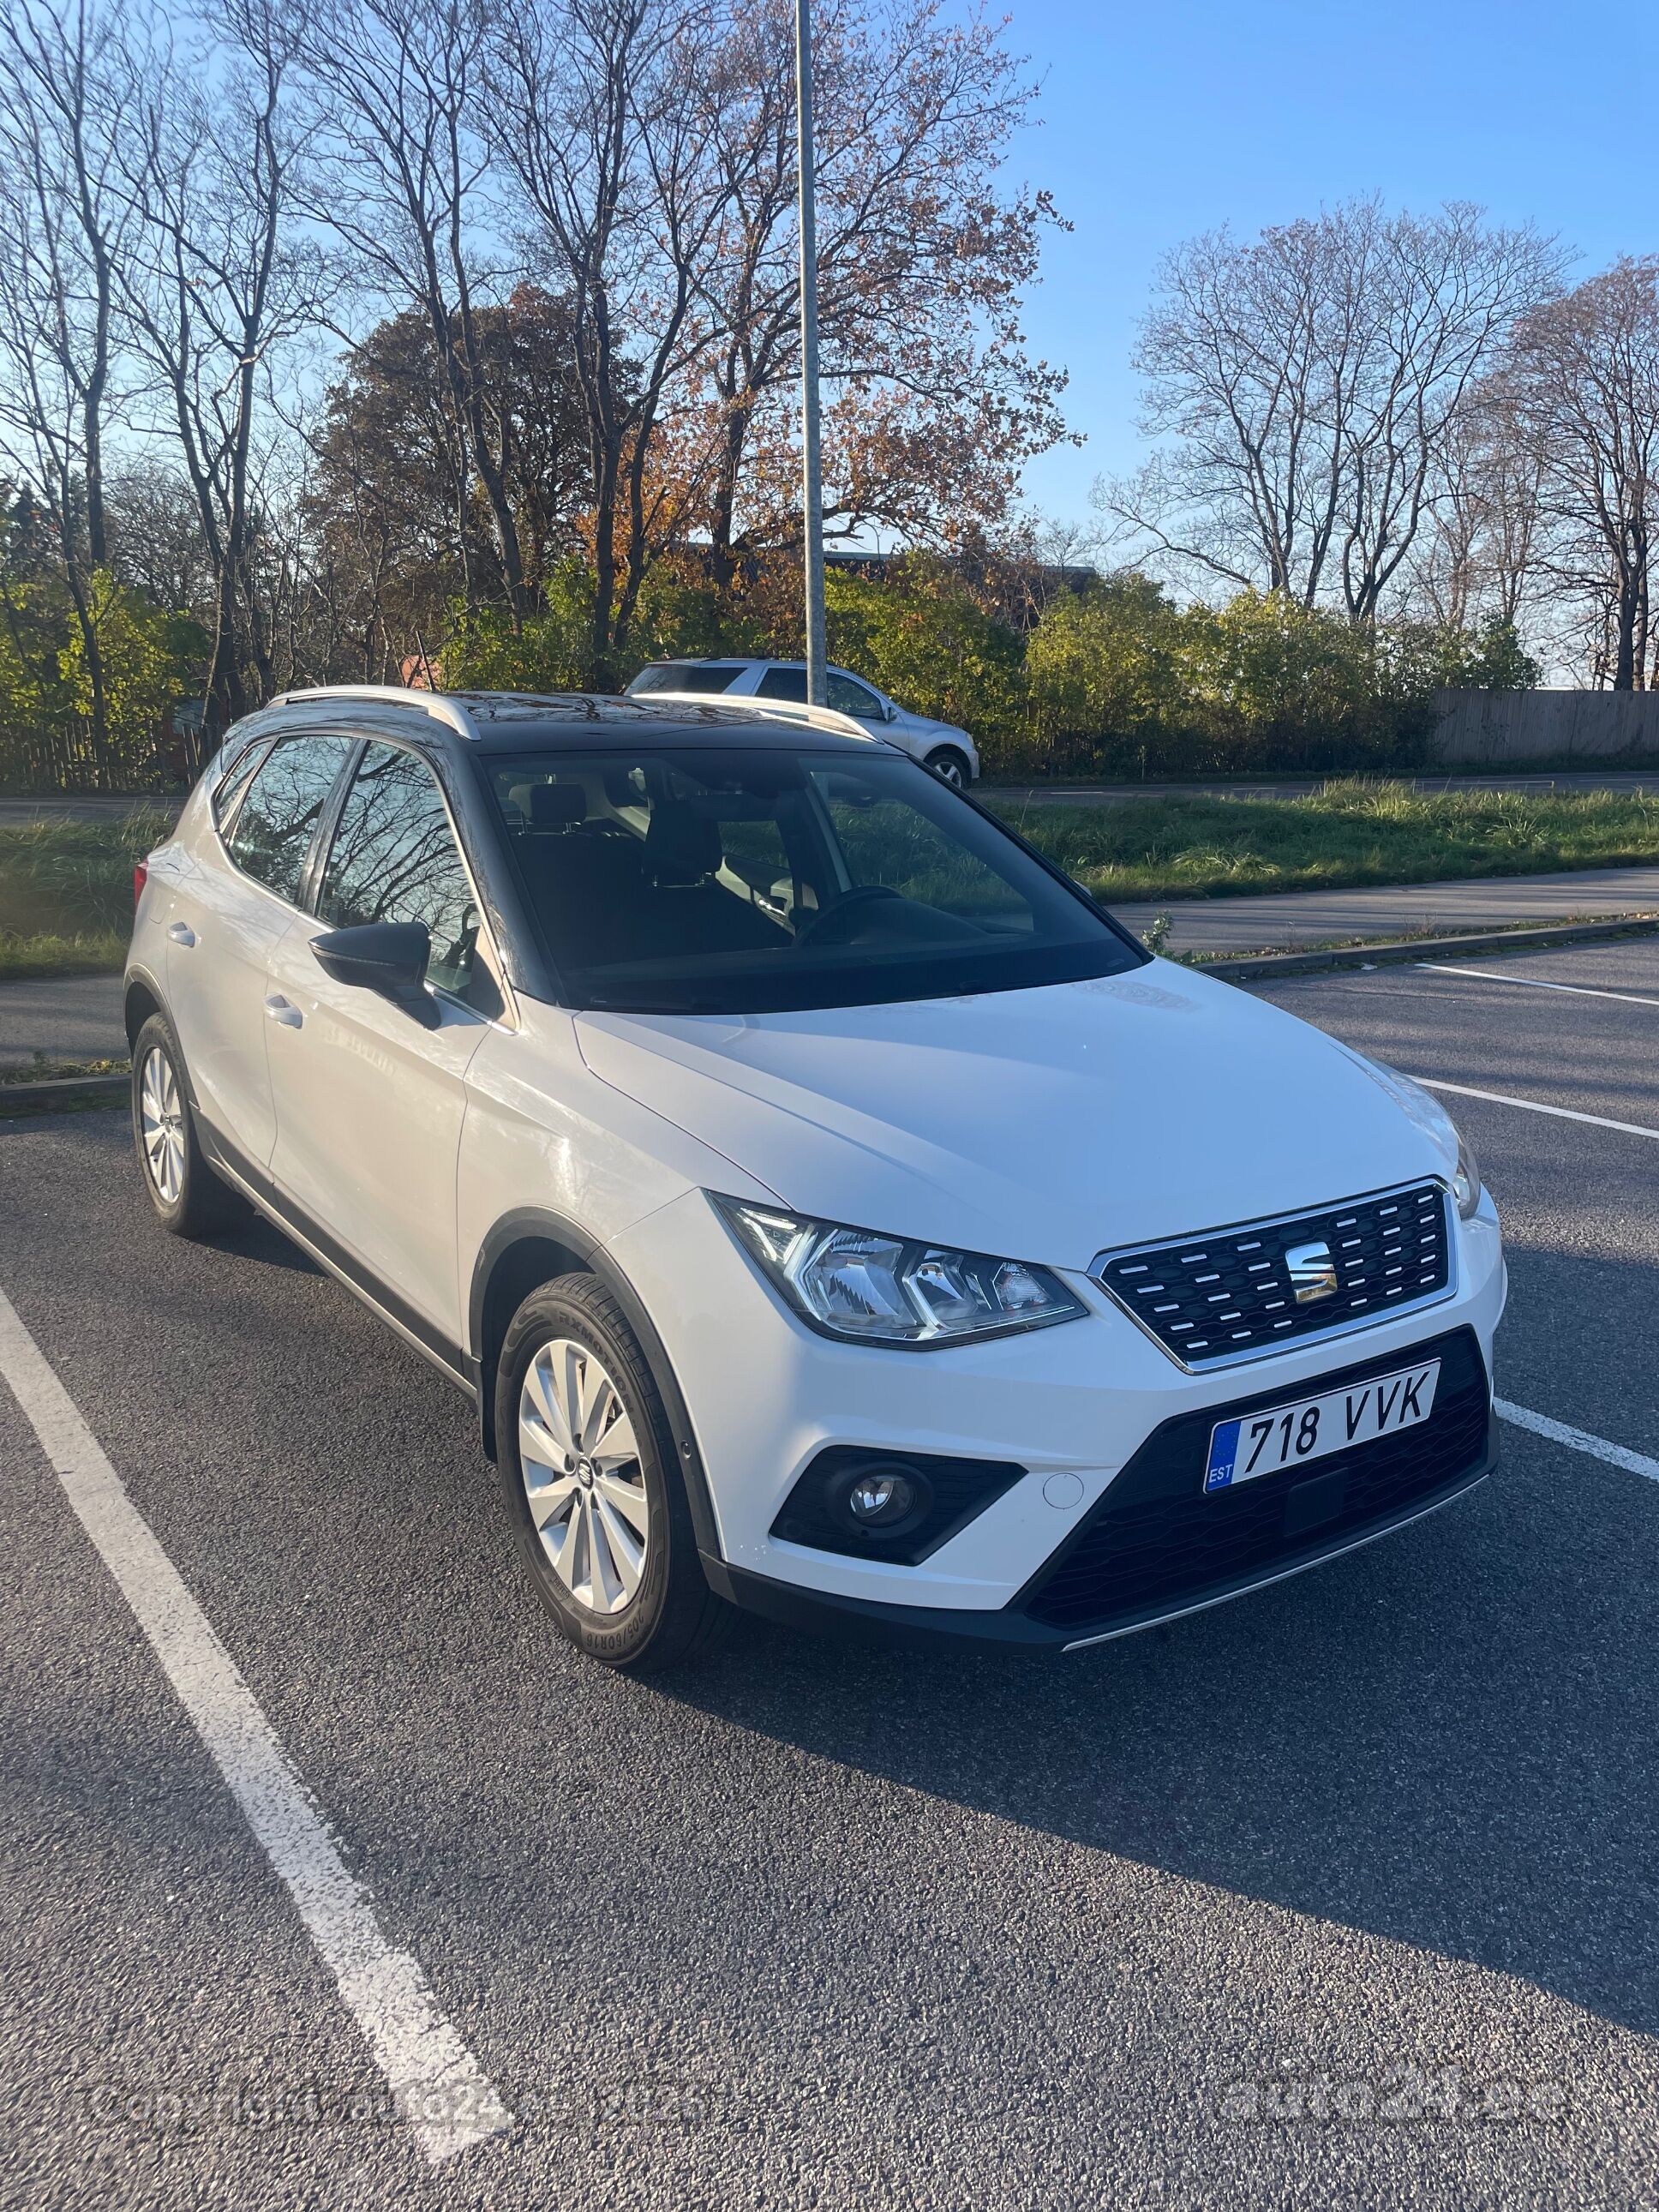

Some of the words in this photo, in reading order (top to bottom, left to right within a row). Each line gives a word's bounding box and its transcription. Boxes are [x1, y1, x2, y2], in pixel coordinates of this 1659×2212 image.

[1244, 1406, 1321, 1473] 718
[1346, 1370, 1430, 1441] VVK
[1208, 1463, 1233, 1483] EST
[586, 1608, 644, 1651] 205/60R16
